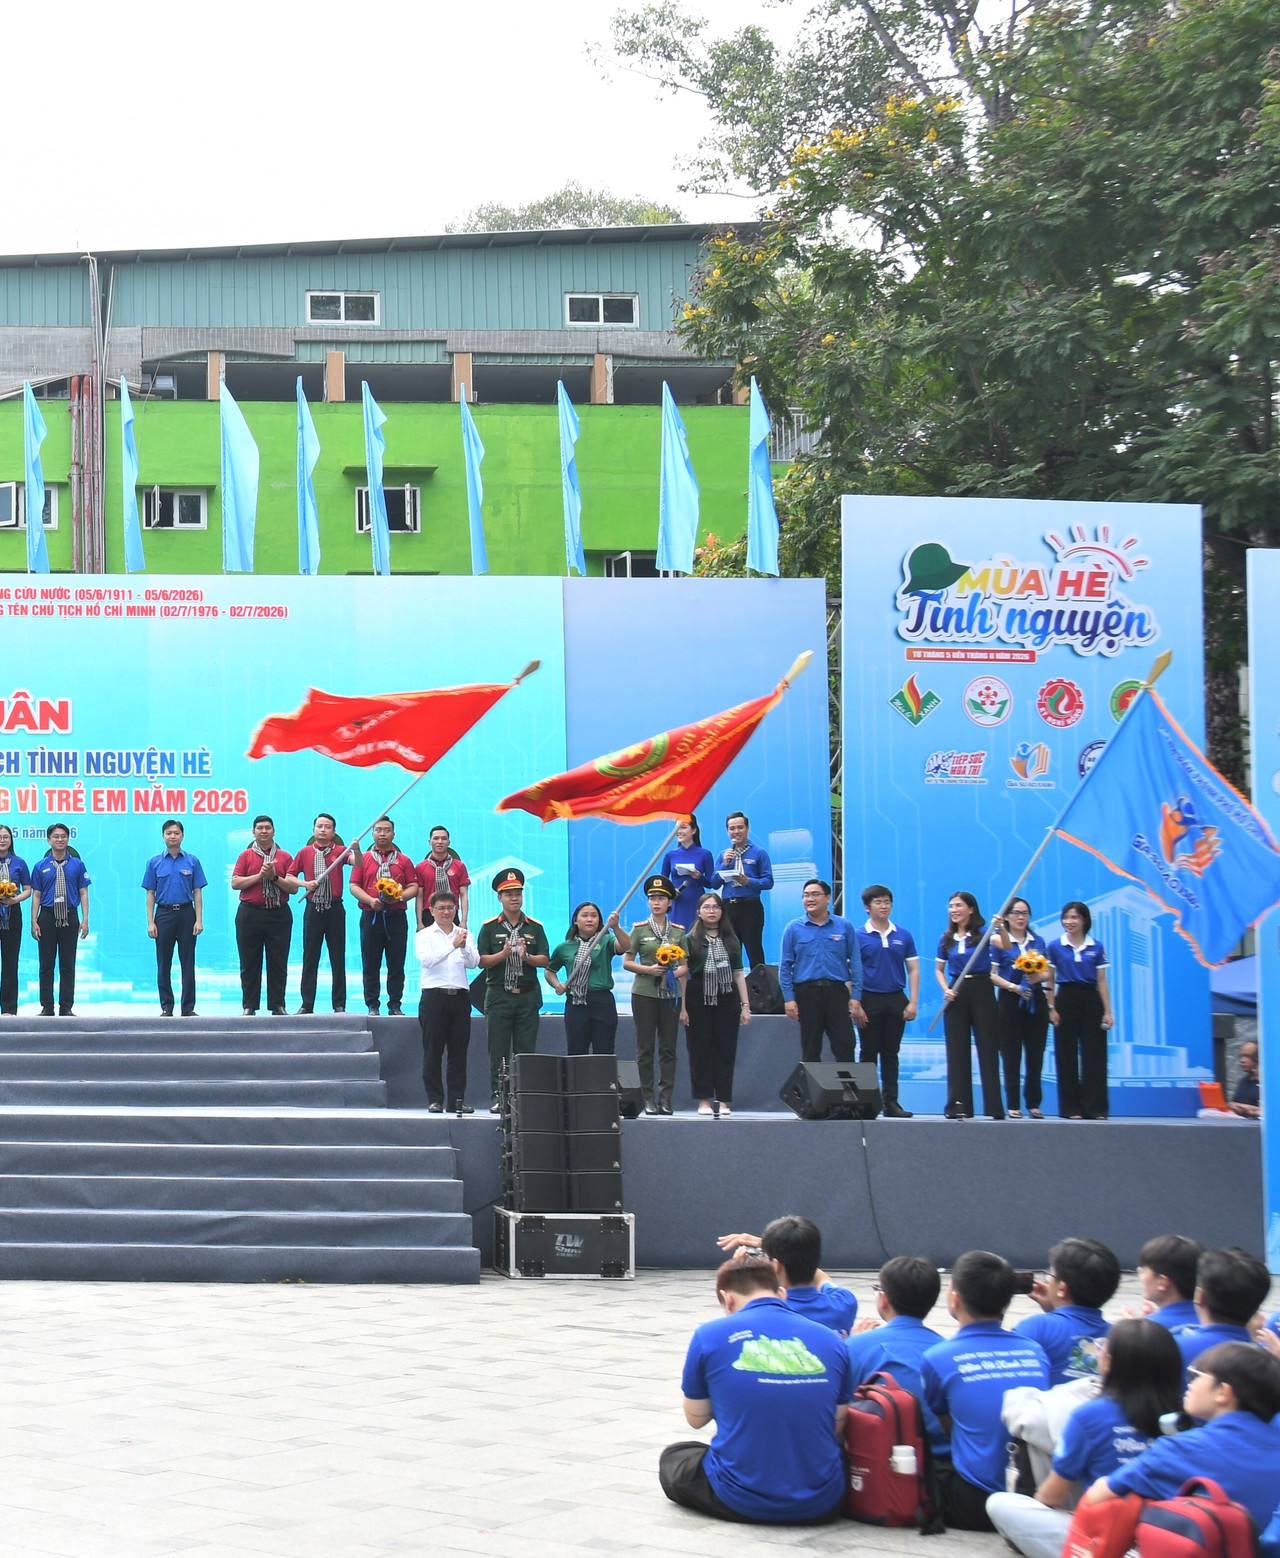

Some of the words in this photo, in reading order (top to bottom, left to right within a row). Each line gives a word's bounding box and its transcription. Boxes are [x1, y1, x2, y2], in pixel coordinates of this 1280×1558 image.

[956, 559, 1045, 597] MÙA
[1056, 563, 1110, 598] HÈ
[14, 587, 37, 600] CỨU
[41, 587, 71, 600] NƯỚC
[75, 588, 133, 601] (05/6/1911
[144, 588, 204, 602] 05/6/2026)
[7, 603, 29, 617] TÊN
[31, 602, 55, 617] CHỦ
[59, 604, 83, 619] TỊCH
[85, 603, 101, 617] HỒ
[104, 604, 123, 617] CHÍ
[126, 605, 156, 617] MINH
[160, 605, 219, 619] (02/7/1976
[230, 605, 289, 619] 02/7/2026)
[905, 589, 994, 634] Tình
[1005, 599, 1152, 649] nguyện
[918, 697, 939, 718] XANH
[28, 746, 78, 775] TÌNH
[86, 746, 175, 780] NGUYỆN
[183, 747, 210, 775] HÈ
[17, 784, 38, 813] VÌ
[45, 782, 85, 813] TRẺ
[92, 789, 127, 813] EM
[133, 785, 186, 813] NĂM
[193, 789, 247, 813] 2026
[22, 826, 47, 839] năm
